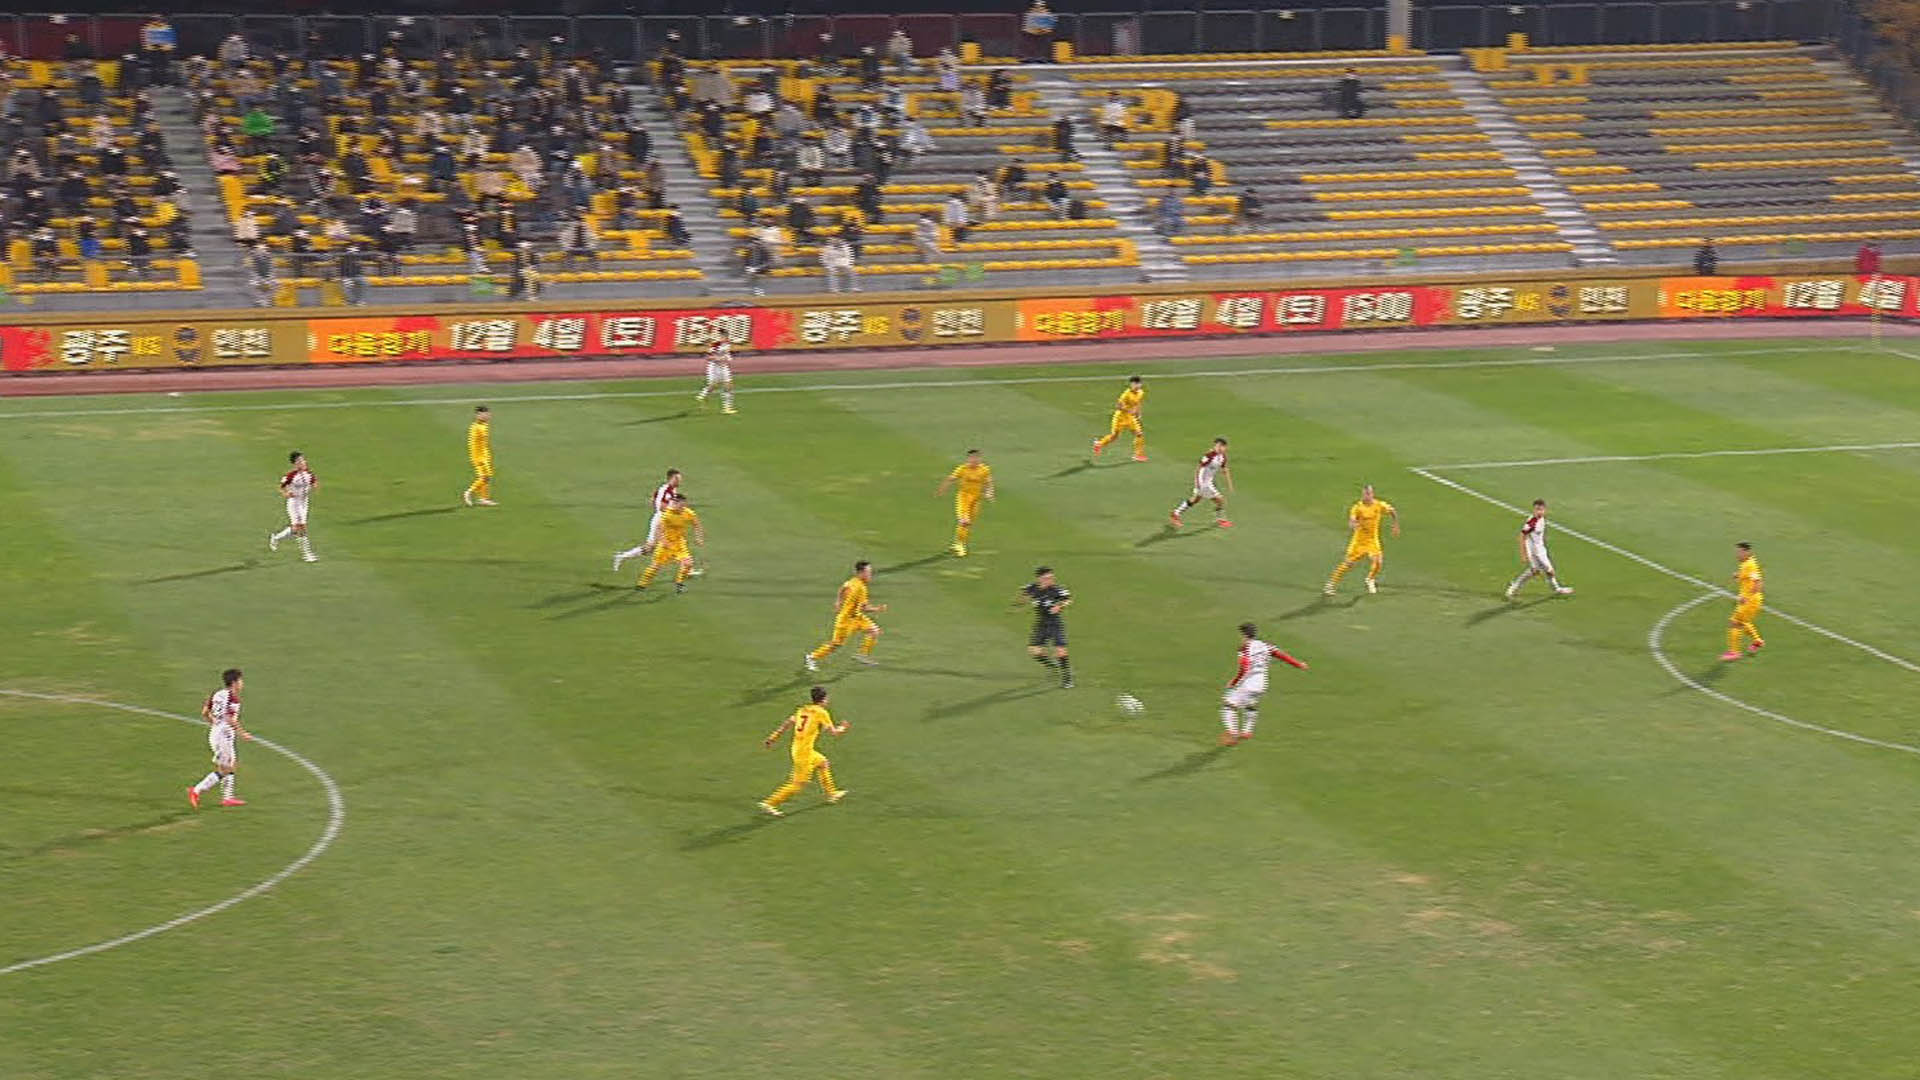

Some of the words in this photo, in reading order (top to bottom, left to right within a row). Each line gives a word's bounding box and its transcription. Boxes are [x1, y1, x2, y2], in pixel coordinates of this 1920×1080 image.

[1141, 299, 1201, 329] 12월
[1274, 294, 1326, 325] (토)
[1784, 280, 1844, 309] 12월
[449, 319, 516, 351] 12월
[601, 316, 655, 347] (토)
